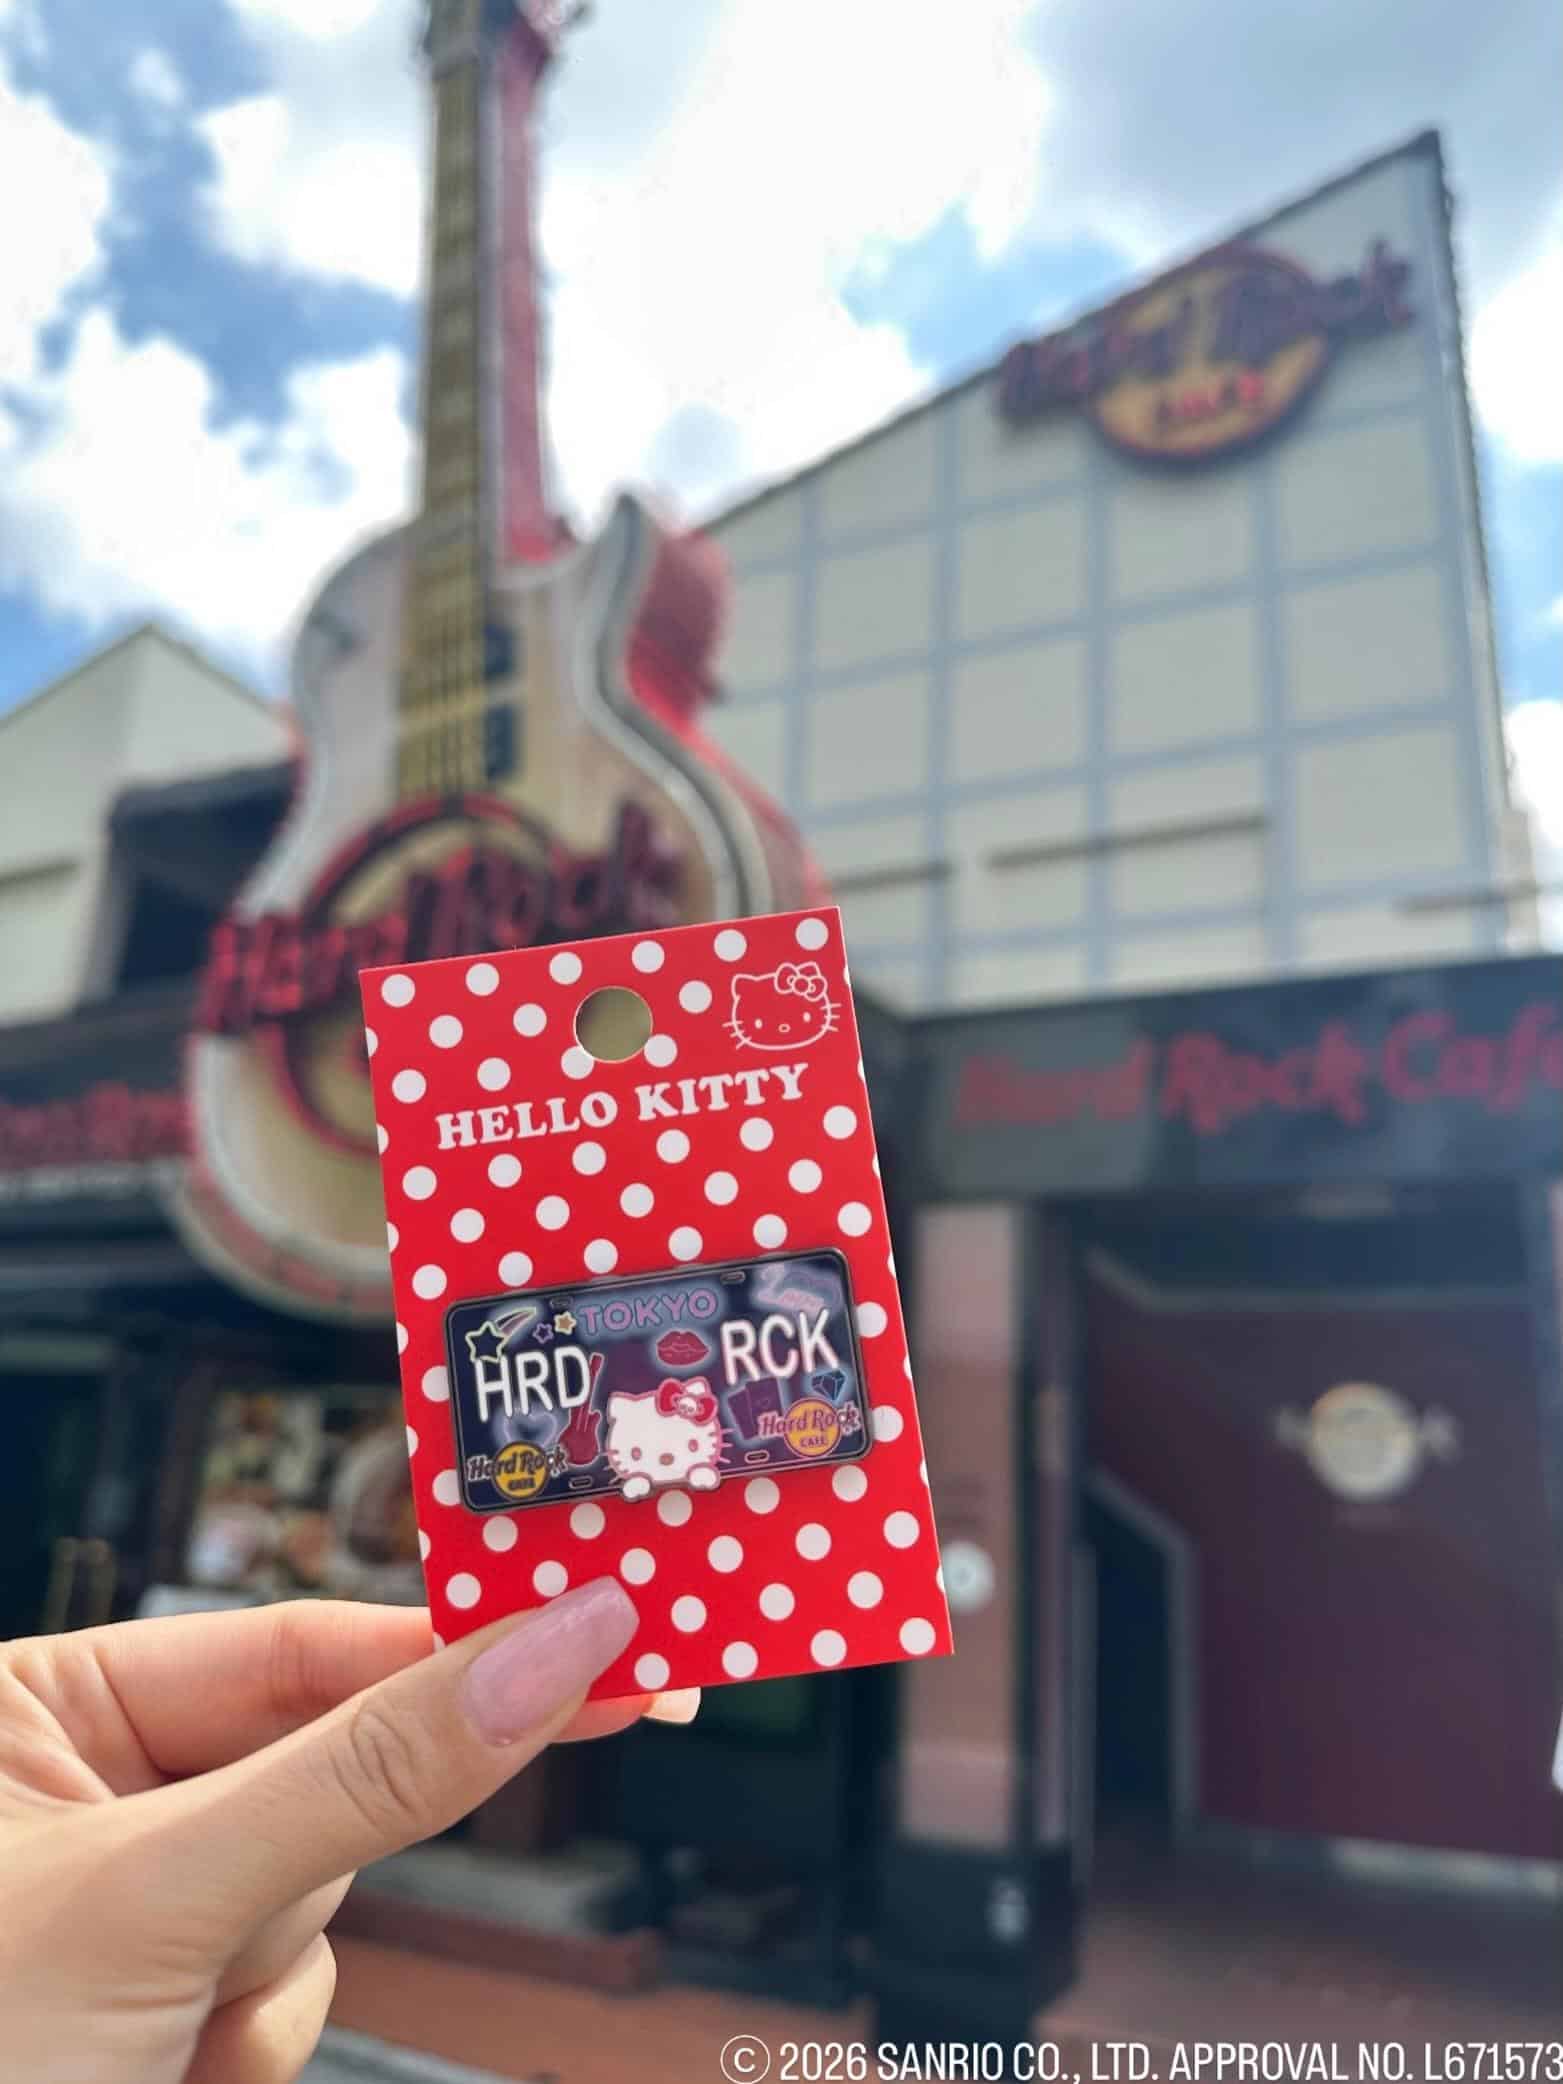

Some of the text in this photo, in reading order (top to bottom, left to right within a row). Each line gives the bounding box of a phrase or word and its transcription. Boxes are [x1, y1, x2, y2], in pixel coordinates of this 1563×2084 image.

[435, 1063, 809, 1150] HELLO KITTY
[1160, 1030, 1368, 1134] Rock
[579, 1288, 718, 1335] TOKYO
[474, 1309, 840, 1422] HRD RCK
[759, 1401, 861, 1437] Hard Rock
[466, 1445, 568, 1482] Hard Rock
